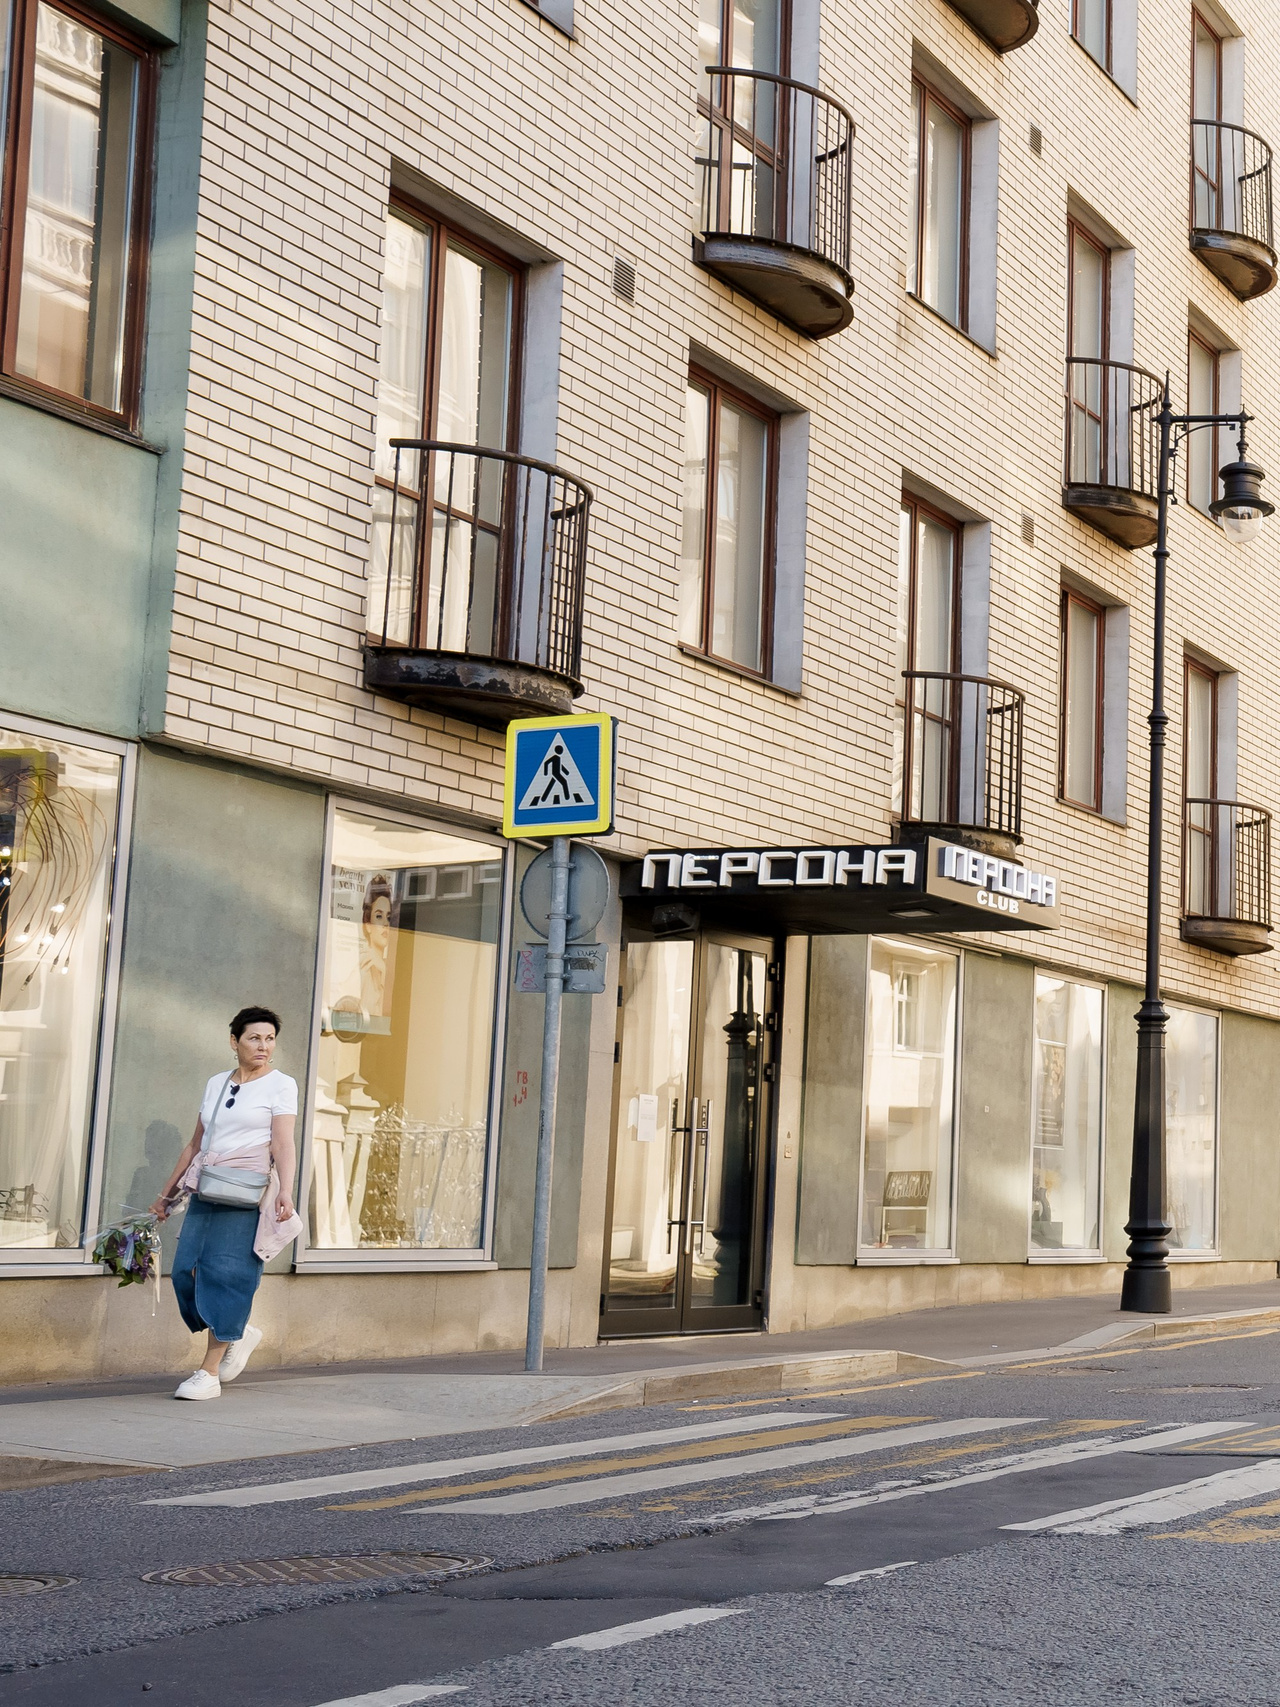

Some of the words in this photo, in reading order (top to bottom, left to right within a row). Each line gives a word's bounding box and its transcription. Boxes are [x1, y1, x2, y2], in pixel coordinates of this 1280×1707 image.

[641, 849, 917, 888] ПЕРСОНА
[940, 846, 1056, 907] ПЕРСОНА
[976, 890, 1019, 914] CLUB
